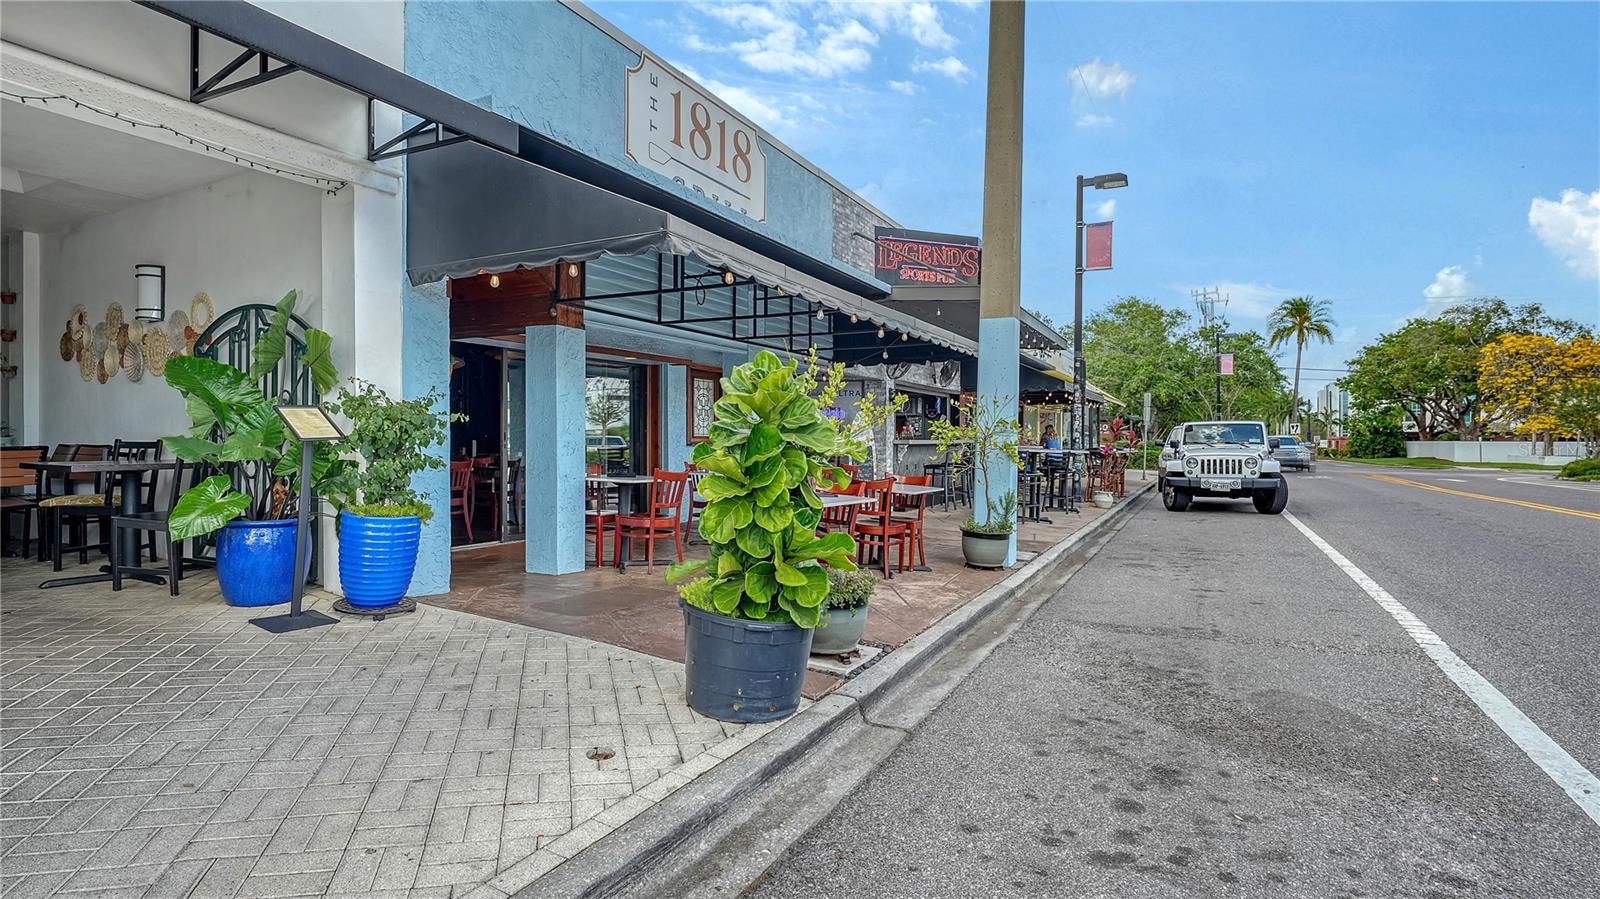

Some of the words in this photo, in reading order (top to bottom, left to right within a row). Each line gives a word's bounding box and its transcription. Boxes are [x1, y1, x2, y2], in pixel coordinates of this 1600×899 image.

[649, 73, 659, 132] THE
[670, 90, 751, 184] 1818
[877, 240, 979, 277] LEGENDS
